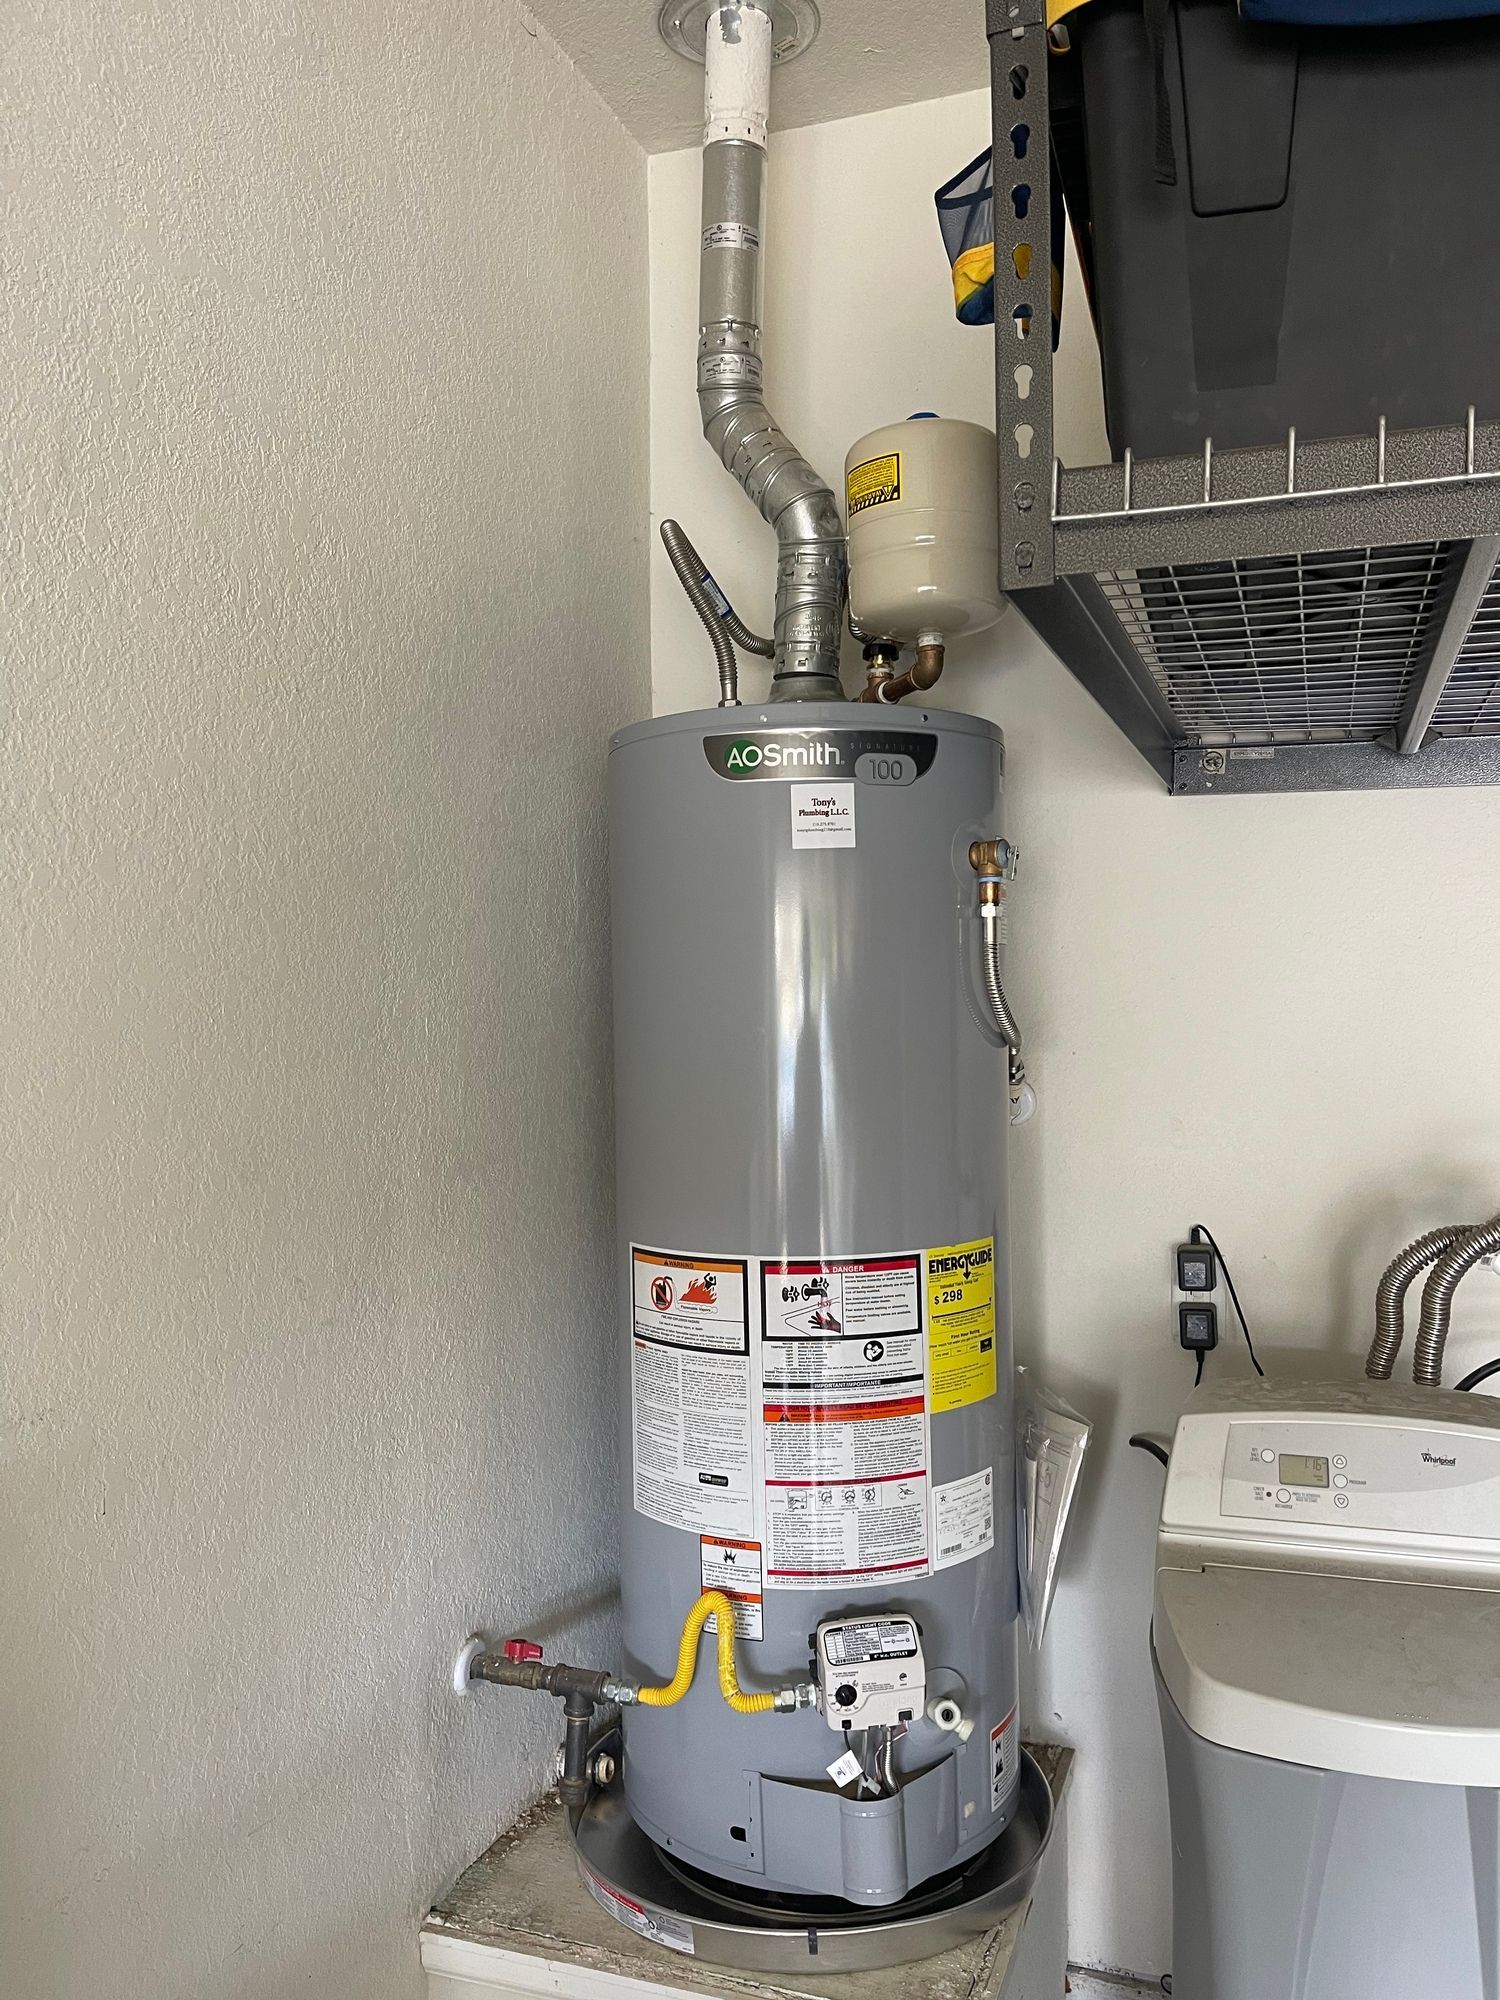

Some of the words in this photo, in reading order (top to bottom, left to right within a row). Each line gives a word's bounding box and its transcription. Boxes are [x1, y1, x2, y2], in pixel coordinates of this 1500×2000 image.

[869, 759, 902, 780] 100
[811, 797, 836, 808] Tony's
[798, 809, 829, 817] Plumbing
[669, 1261, 694, 1269] WARNING
[929, 1248, 992, 1275] ENERGYGUIDE
[833, 1265, 864, 1273] DANGER
[934, 1296, 939, 1305] $
[942, 1289, 963, 1303] 298
[1421, 1453, 1456, 1466] Whirlpool
[718, 1540, 746, 1548] WARNING
